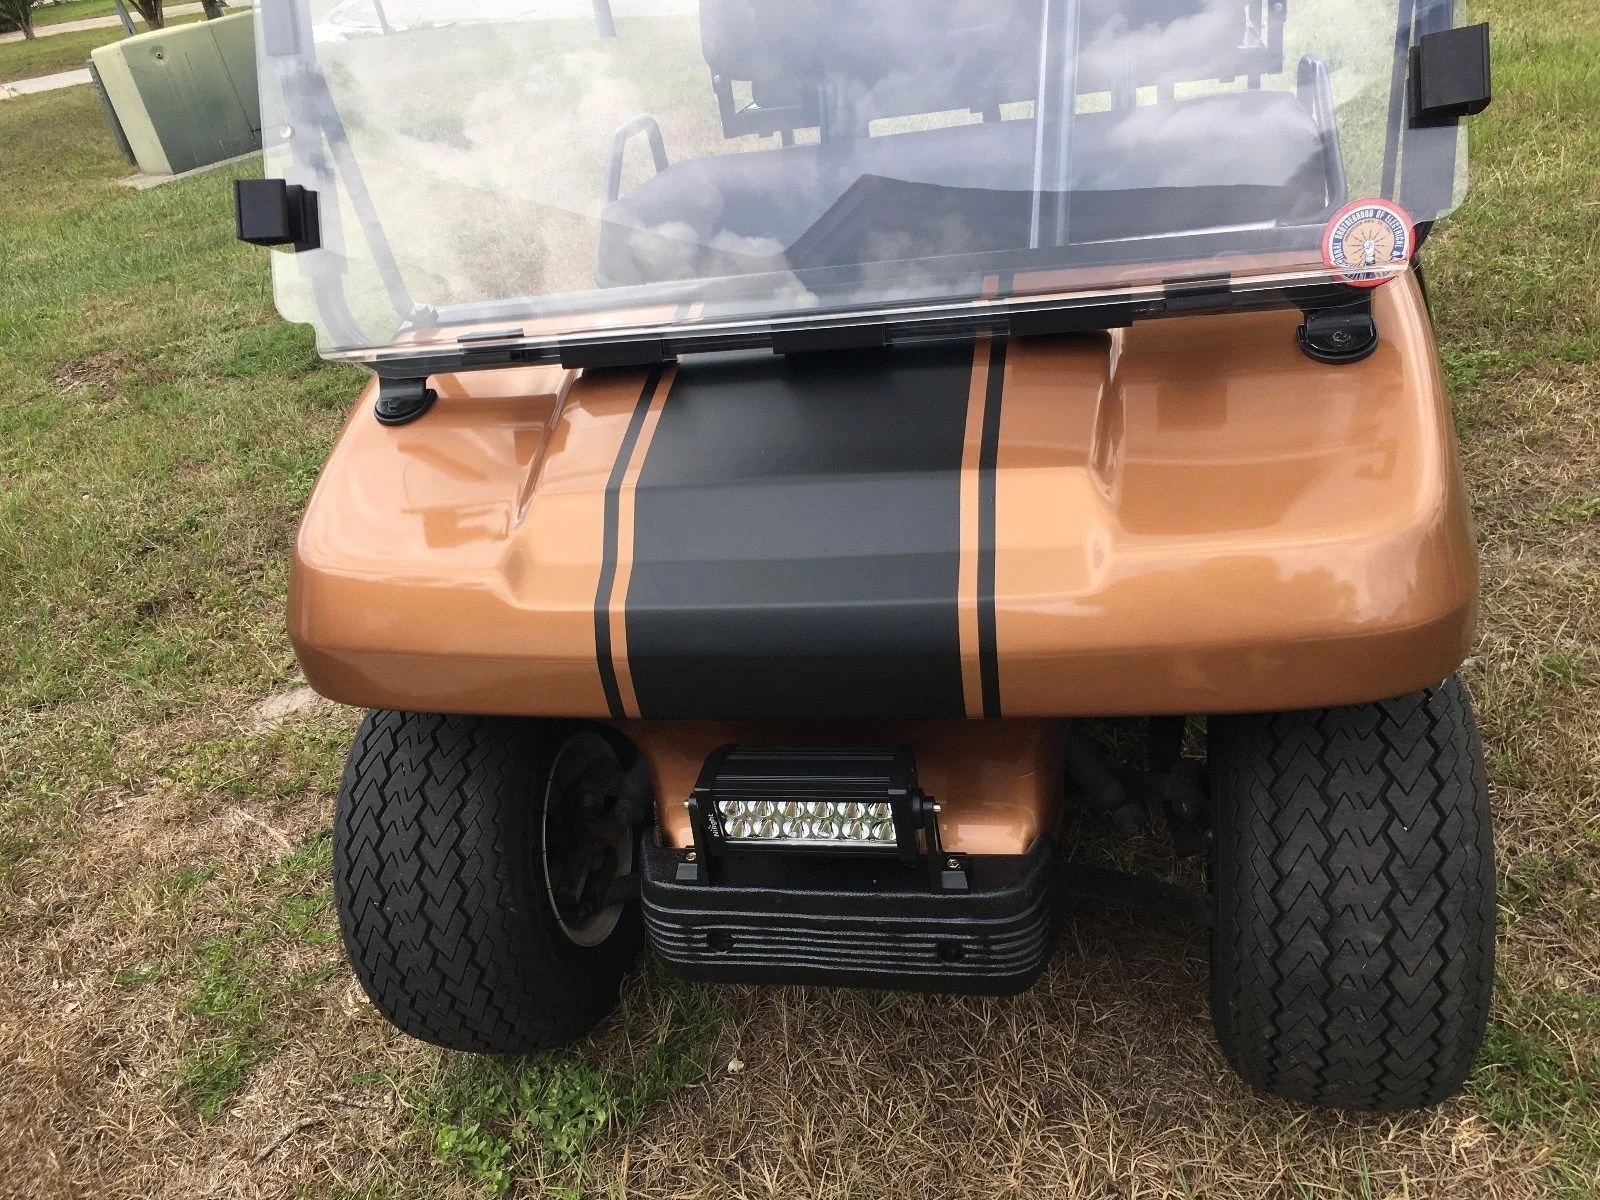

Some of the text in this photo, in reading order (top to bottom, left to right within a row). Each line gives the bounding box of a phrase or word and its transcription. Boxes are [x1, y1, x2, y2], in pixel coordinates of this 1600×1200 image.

[1335, 209, 1374, 239] BROTHERHOOD
[1376, 210, 1385, 219] OF
[1386, 214, 1404, 248] ELECTRICAL
[707, 813, 719, 837] Nilight
